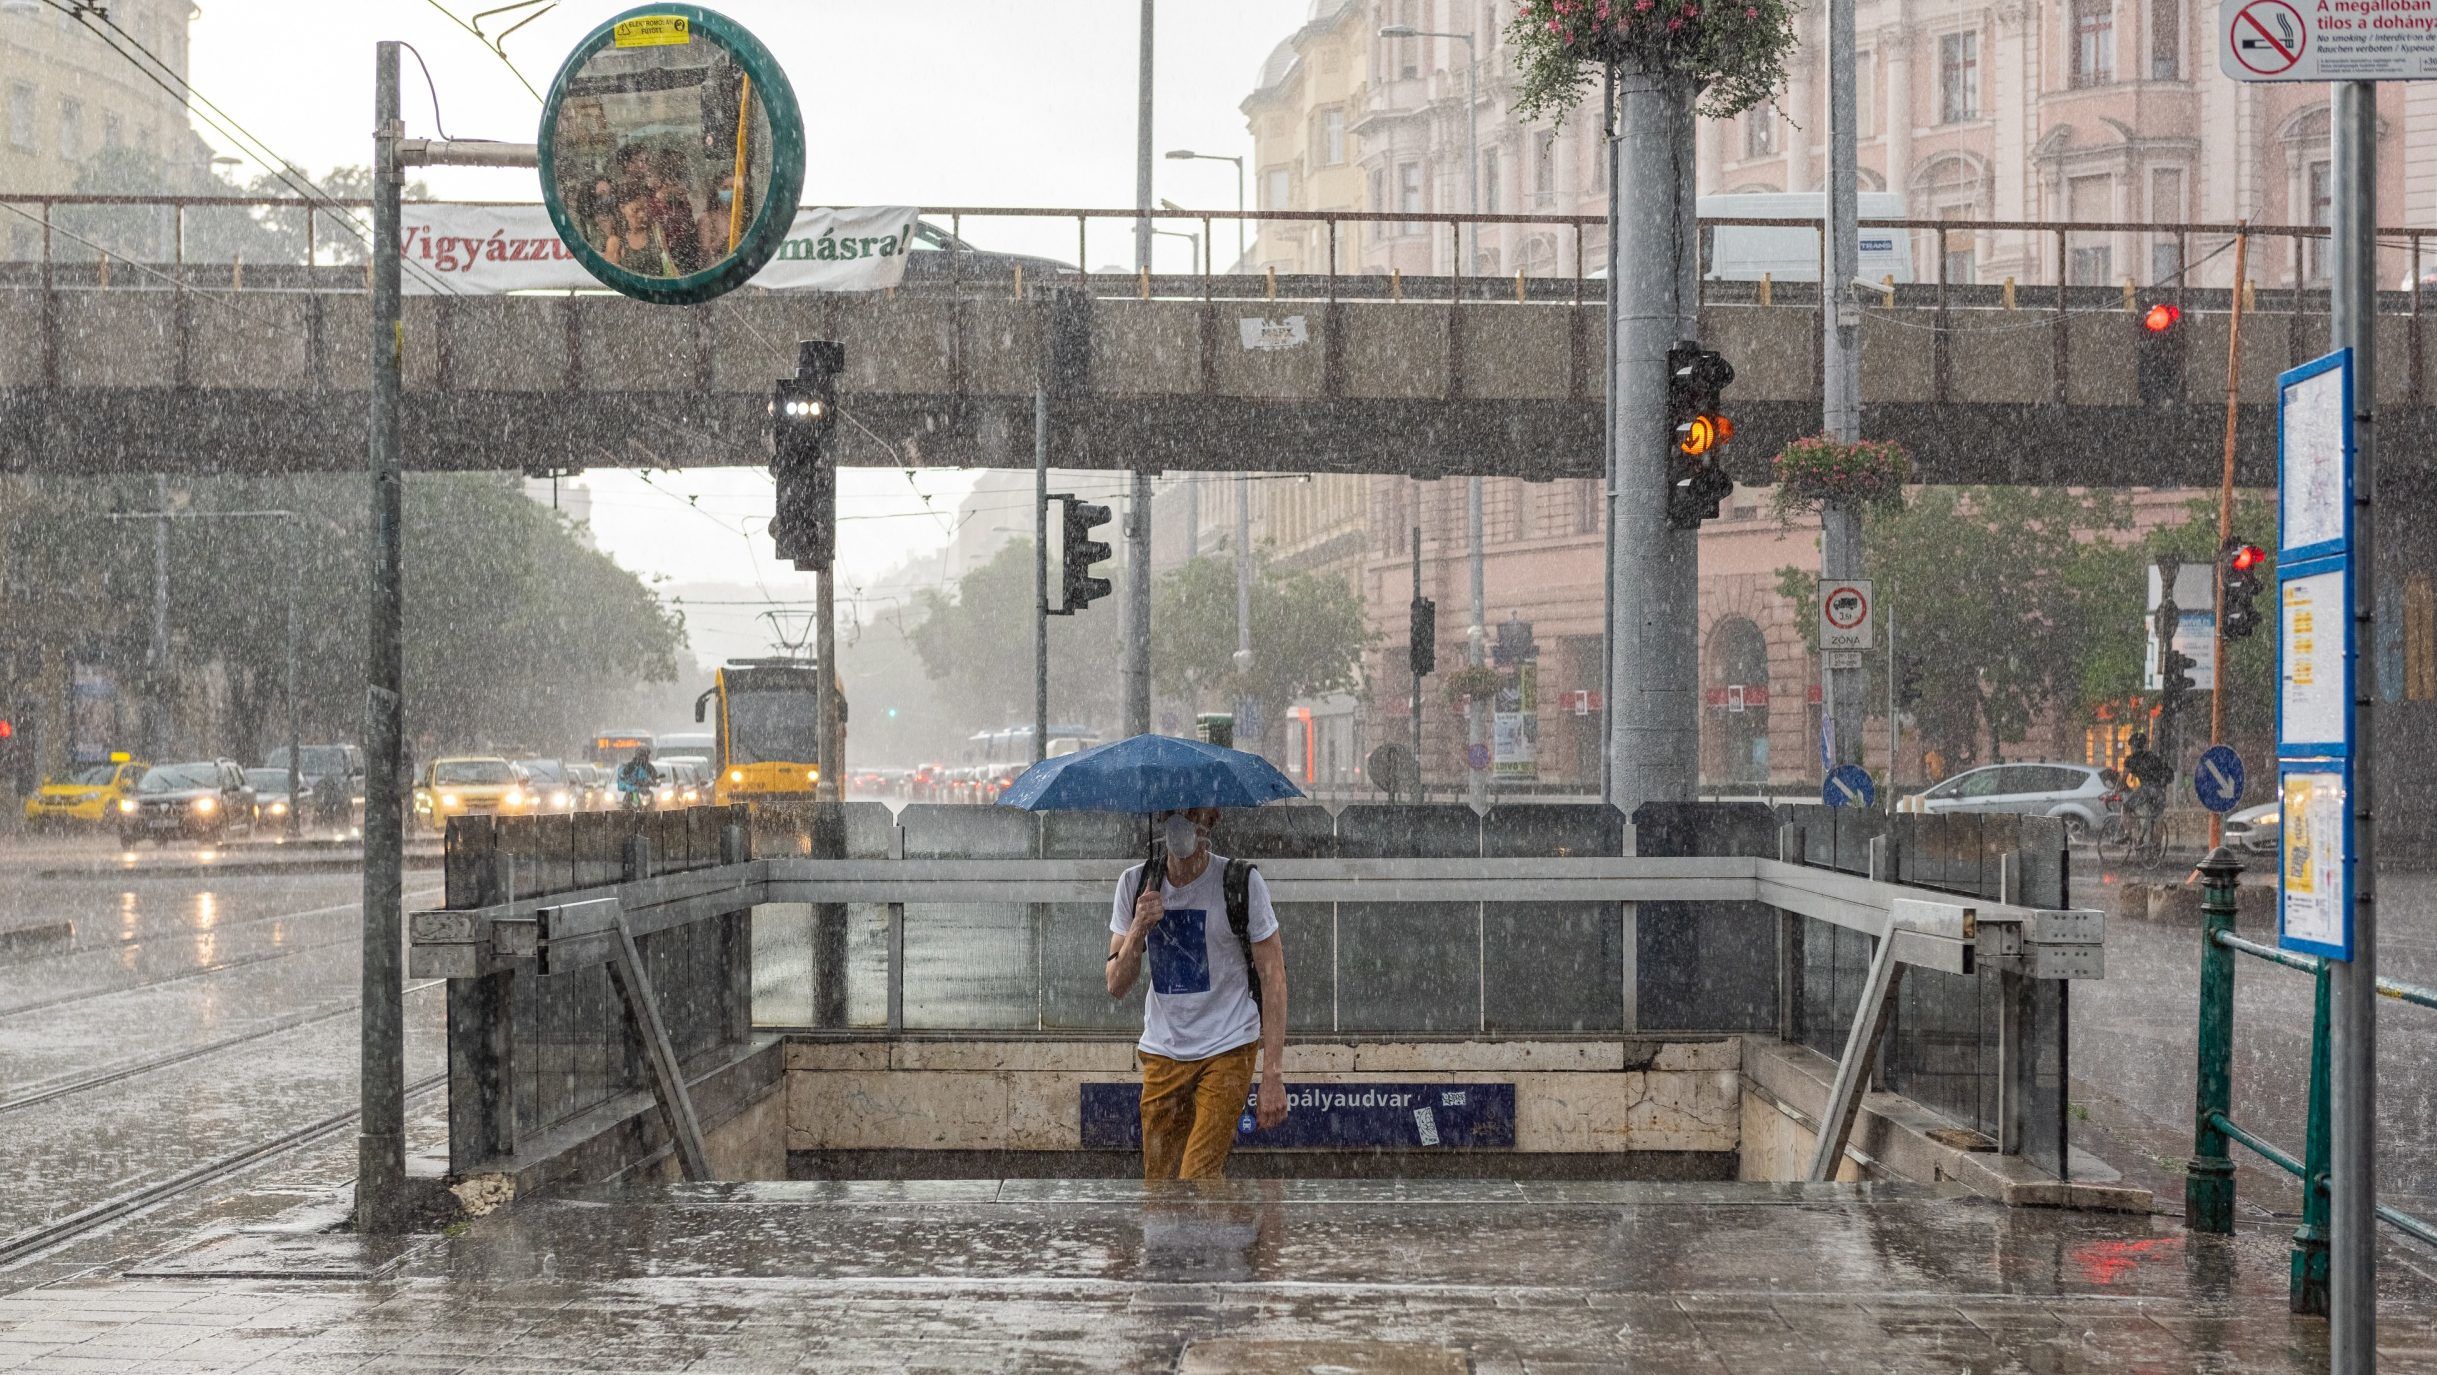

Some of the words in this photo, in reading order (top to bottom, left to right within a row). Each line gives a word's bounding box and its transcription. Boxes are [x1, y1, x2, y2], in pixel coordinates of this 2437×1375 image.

[2317, 0, 2329, 12] A
[2317, 16, 2352, 30] tilos
[2358, 18, 2367, 29] a
[2317, 34, 2329, 42] No
[2332, 34, 2367, 43] smoking
[2317, 44, 2353, 54] Rauchen
[2355, 44, 2393, 53] verboten
[777, 224, 910, 261] másra!
[1287, 1089, 1412, 1112] pályaudvar
